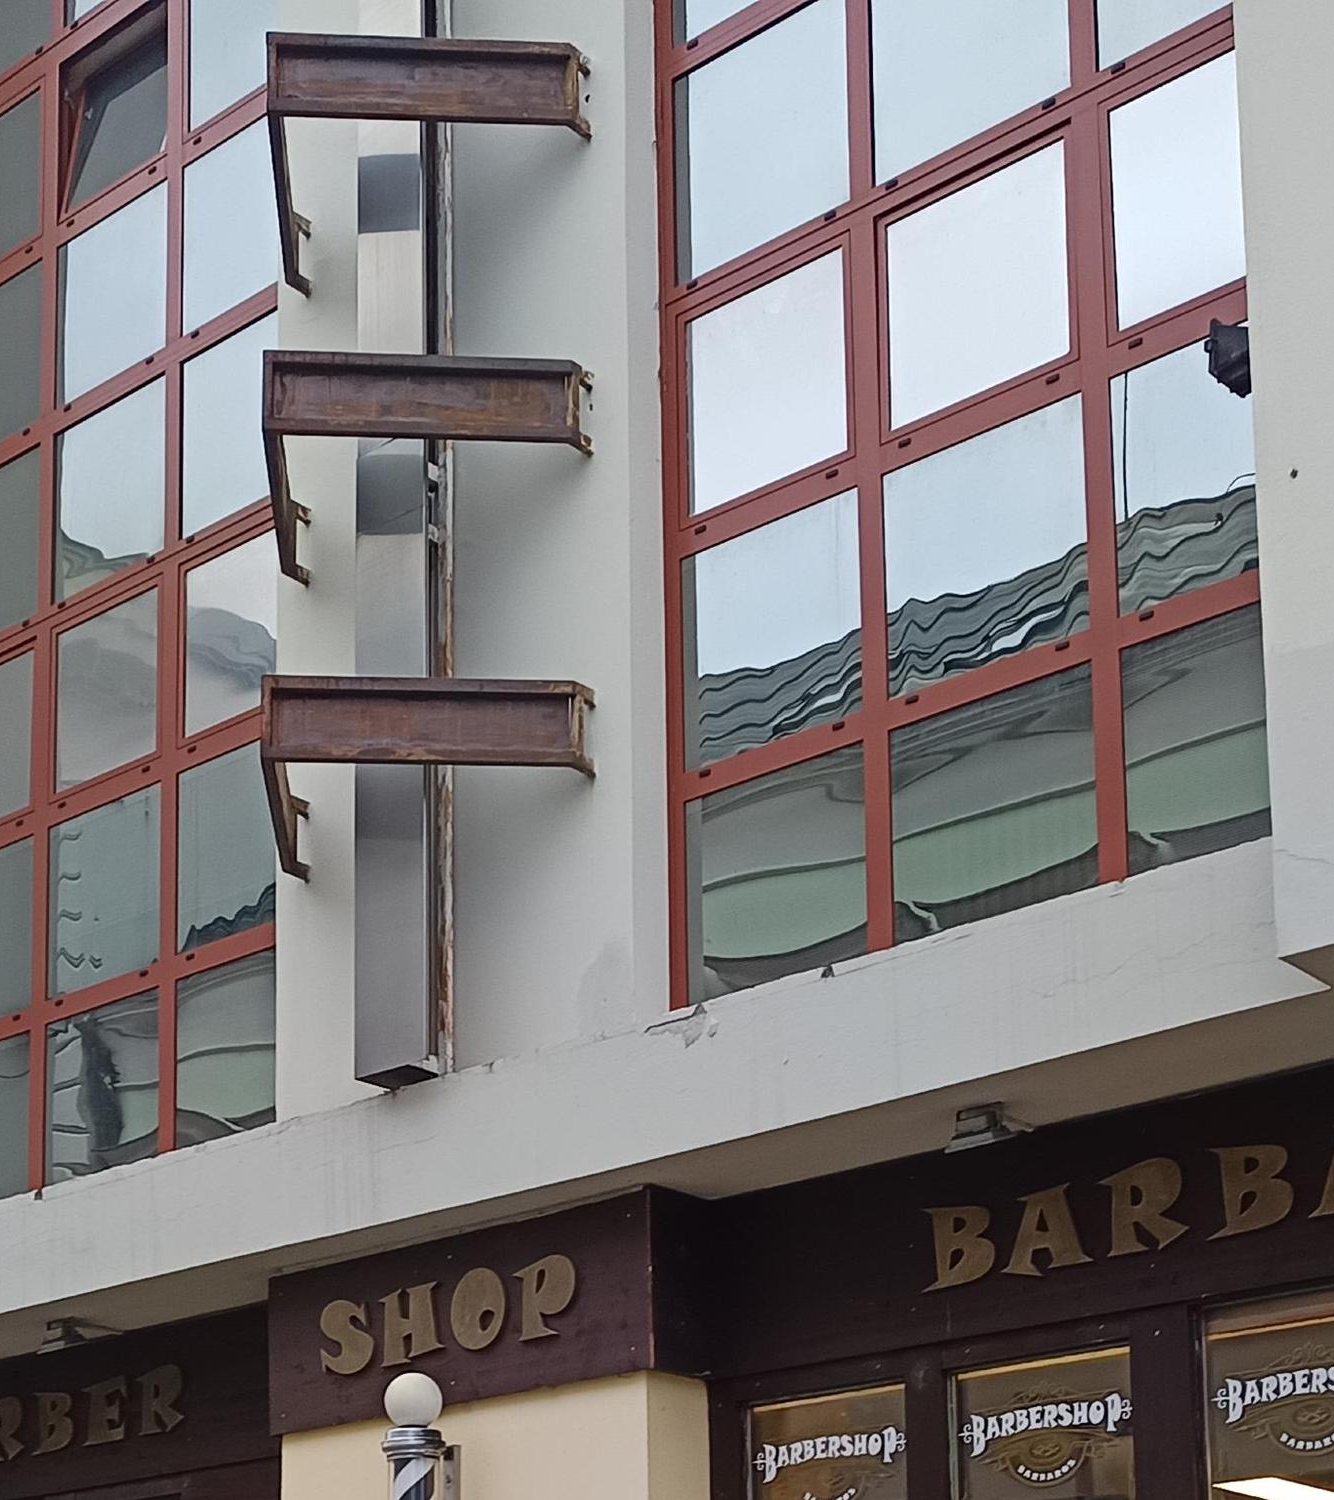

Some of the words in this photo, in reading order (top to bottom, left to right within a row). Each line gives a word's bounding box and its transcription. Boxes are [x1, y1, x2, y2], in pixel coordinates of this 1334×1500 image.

[319, 1254, 576, 1376] SHOP
[763, 1426, 898, 1484] BARBERSHOP
[970, 1393, 1122, 1457] BARBERSHOP
[1017, 1458, 1077, 1482] BARBAROS
